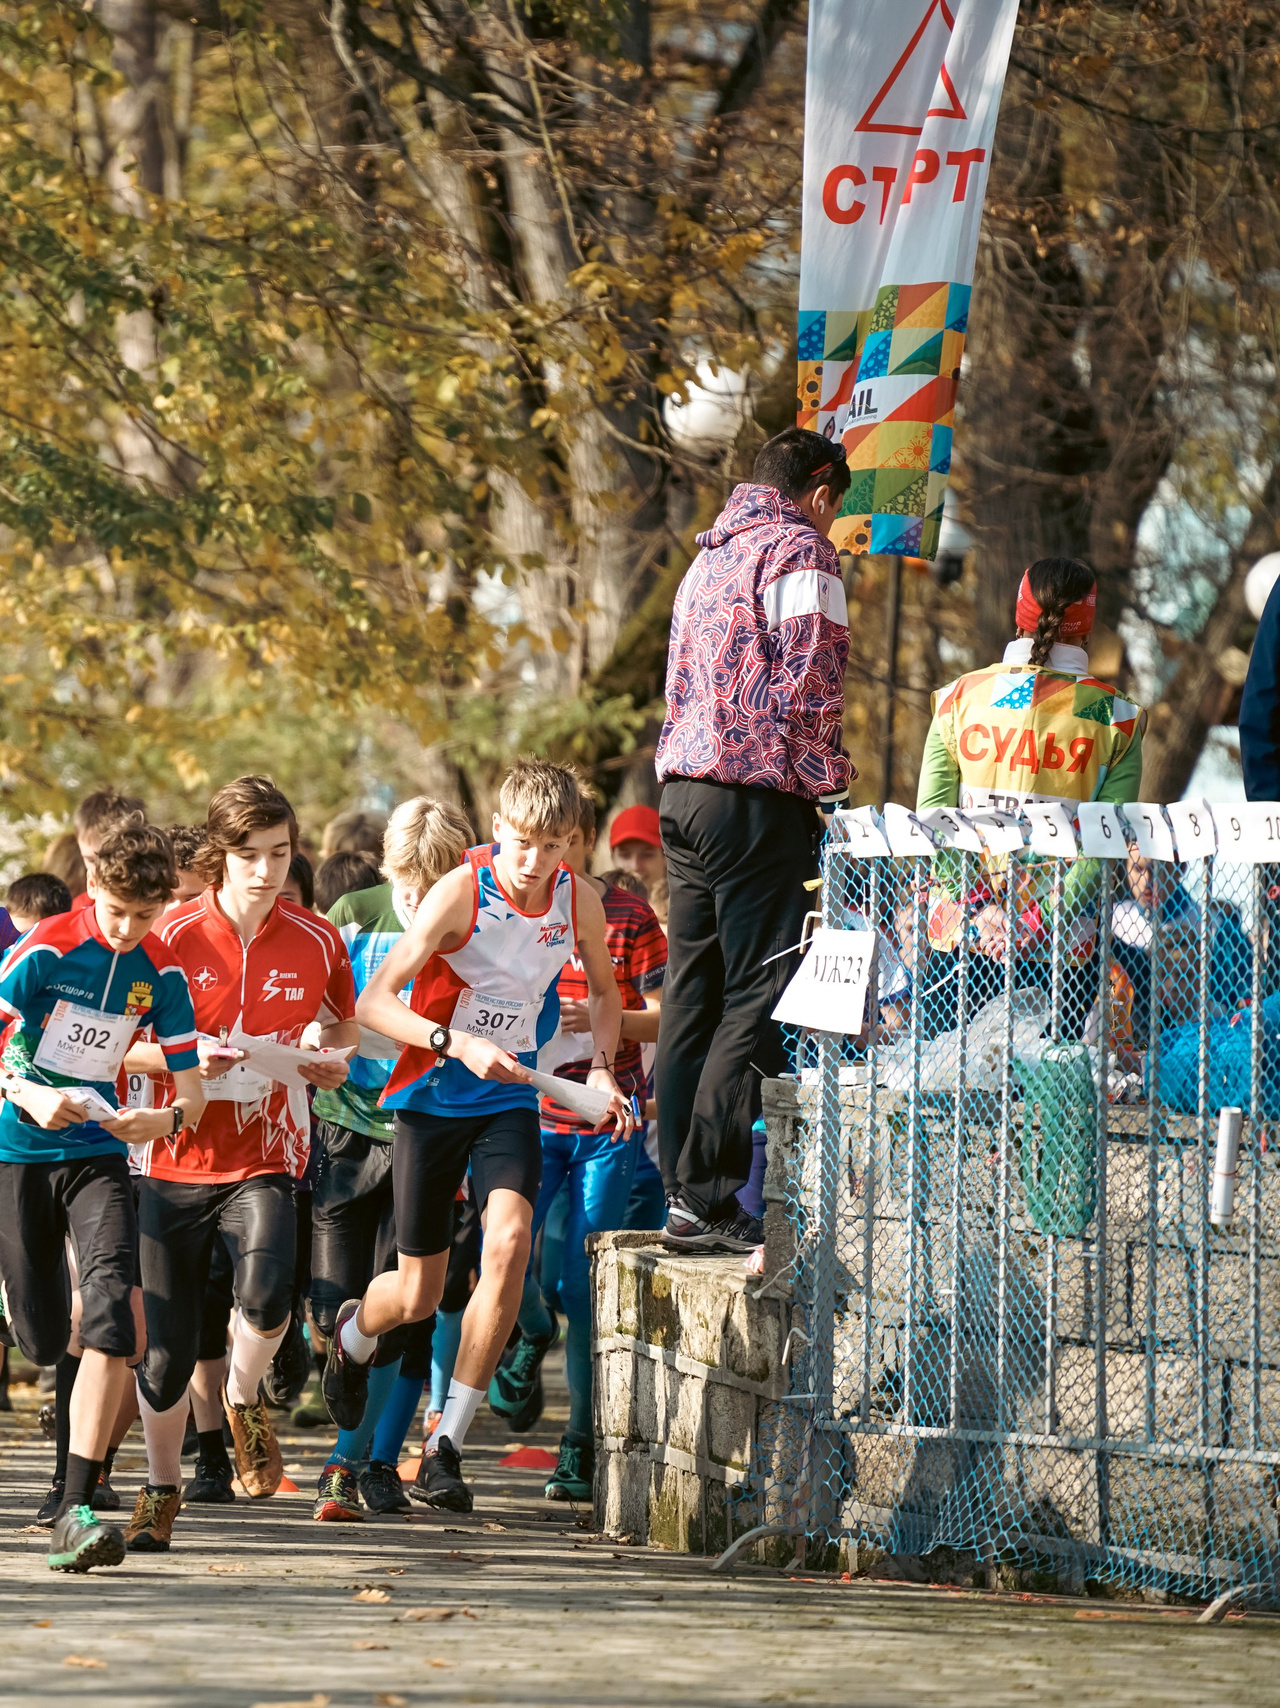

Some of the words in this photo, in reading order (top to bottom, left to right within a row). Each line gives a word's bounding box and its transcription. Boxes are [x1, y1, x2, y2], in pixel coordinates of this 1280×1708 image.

[822, 148, 986, 226] СТРТ
[959, 723, 1095, 775] СУДЬЯ
[940, 815, 960, 832] 3
[988, 816, 1006, 832] 4
[1043, 815, 1058, 837] 5
[1100, 815, 1112, 839] 6
[1142, 815, 1154, 839] 7
[1188, 813, 1202, 837] 8
[1230, 817, 1242, 841] 9
[466, 1023, 495, 1037] МЖ14
[475, 1009, 519, 1031] 307
[520, 1018, 526, 1027] 1
[67, 1023, 111, 1049] 302
[113, 1041, 120, 1053] 1
[56, 1039, 86, 1056] МЖ14
